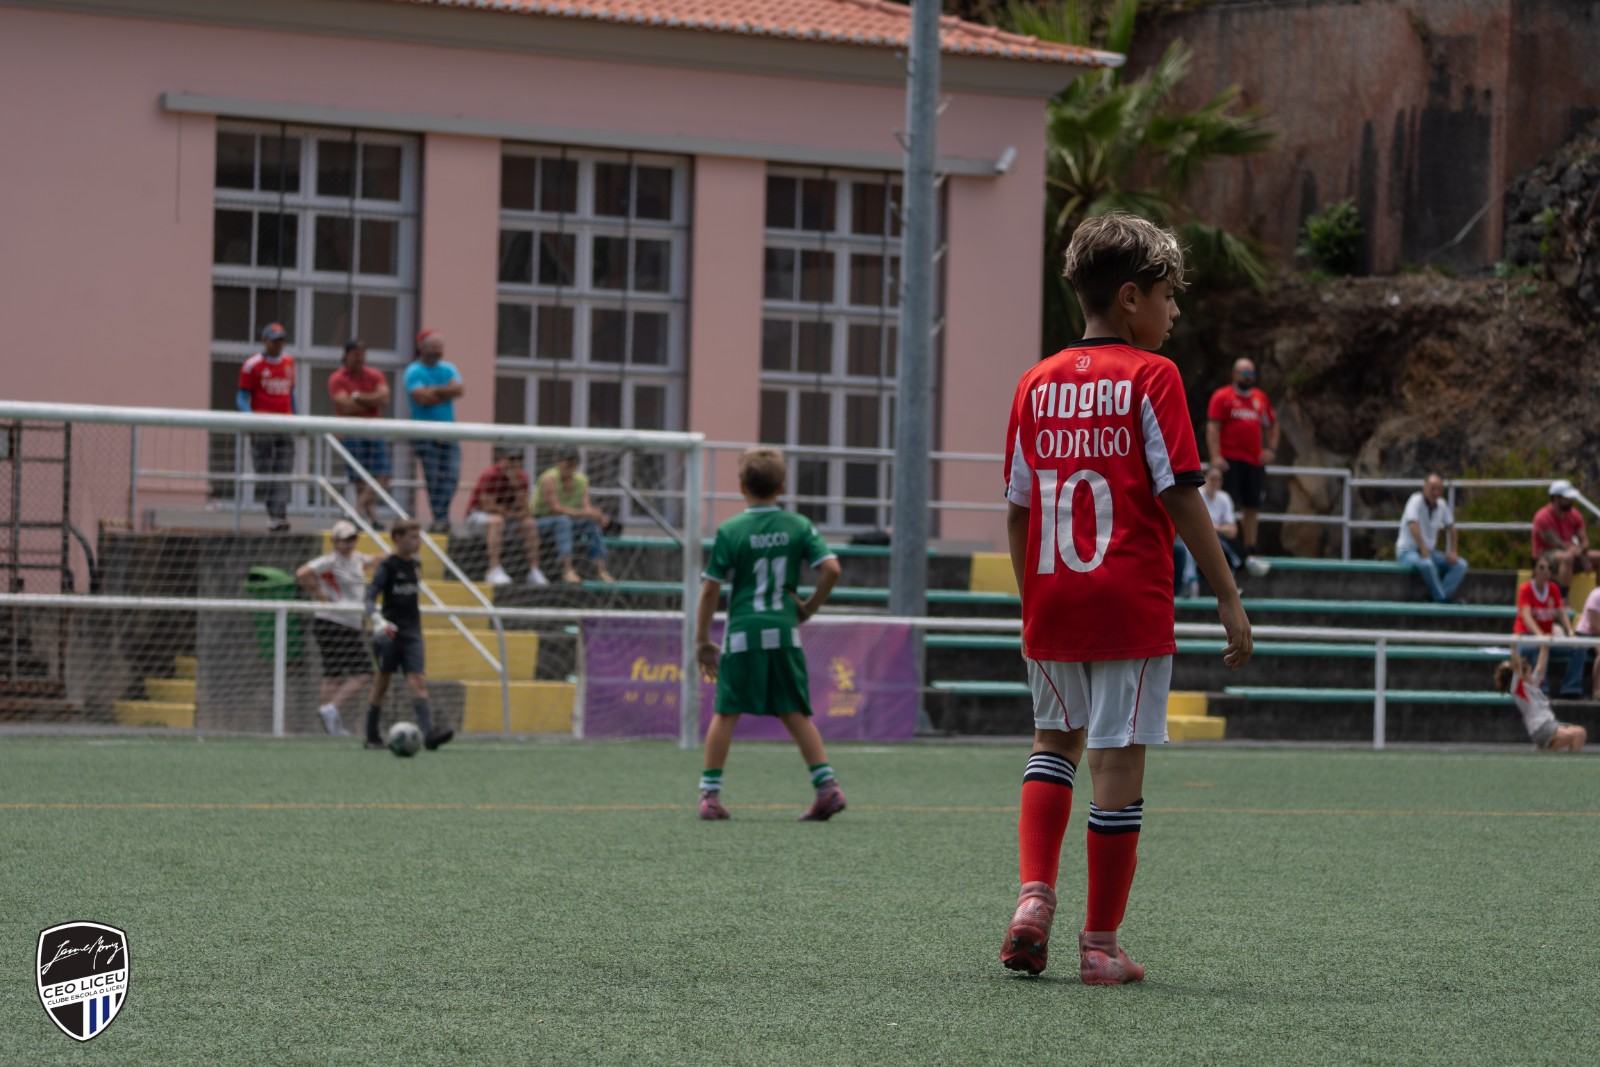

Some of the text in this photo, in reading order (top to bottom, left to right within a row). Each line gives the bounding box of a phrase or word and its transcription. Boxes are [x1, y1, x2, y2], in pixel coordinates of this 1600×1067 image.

[1036, 426, 1131, 459] ODRIGO
[750, 533, 789, 548] ROCCO
[1035, 469, 1113, 574] 10
[753, 556, 787, 612] 11
